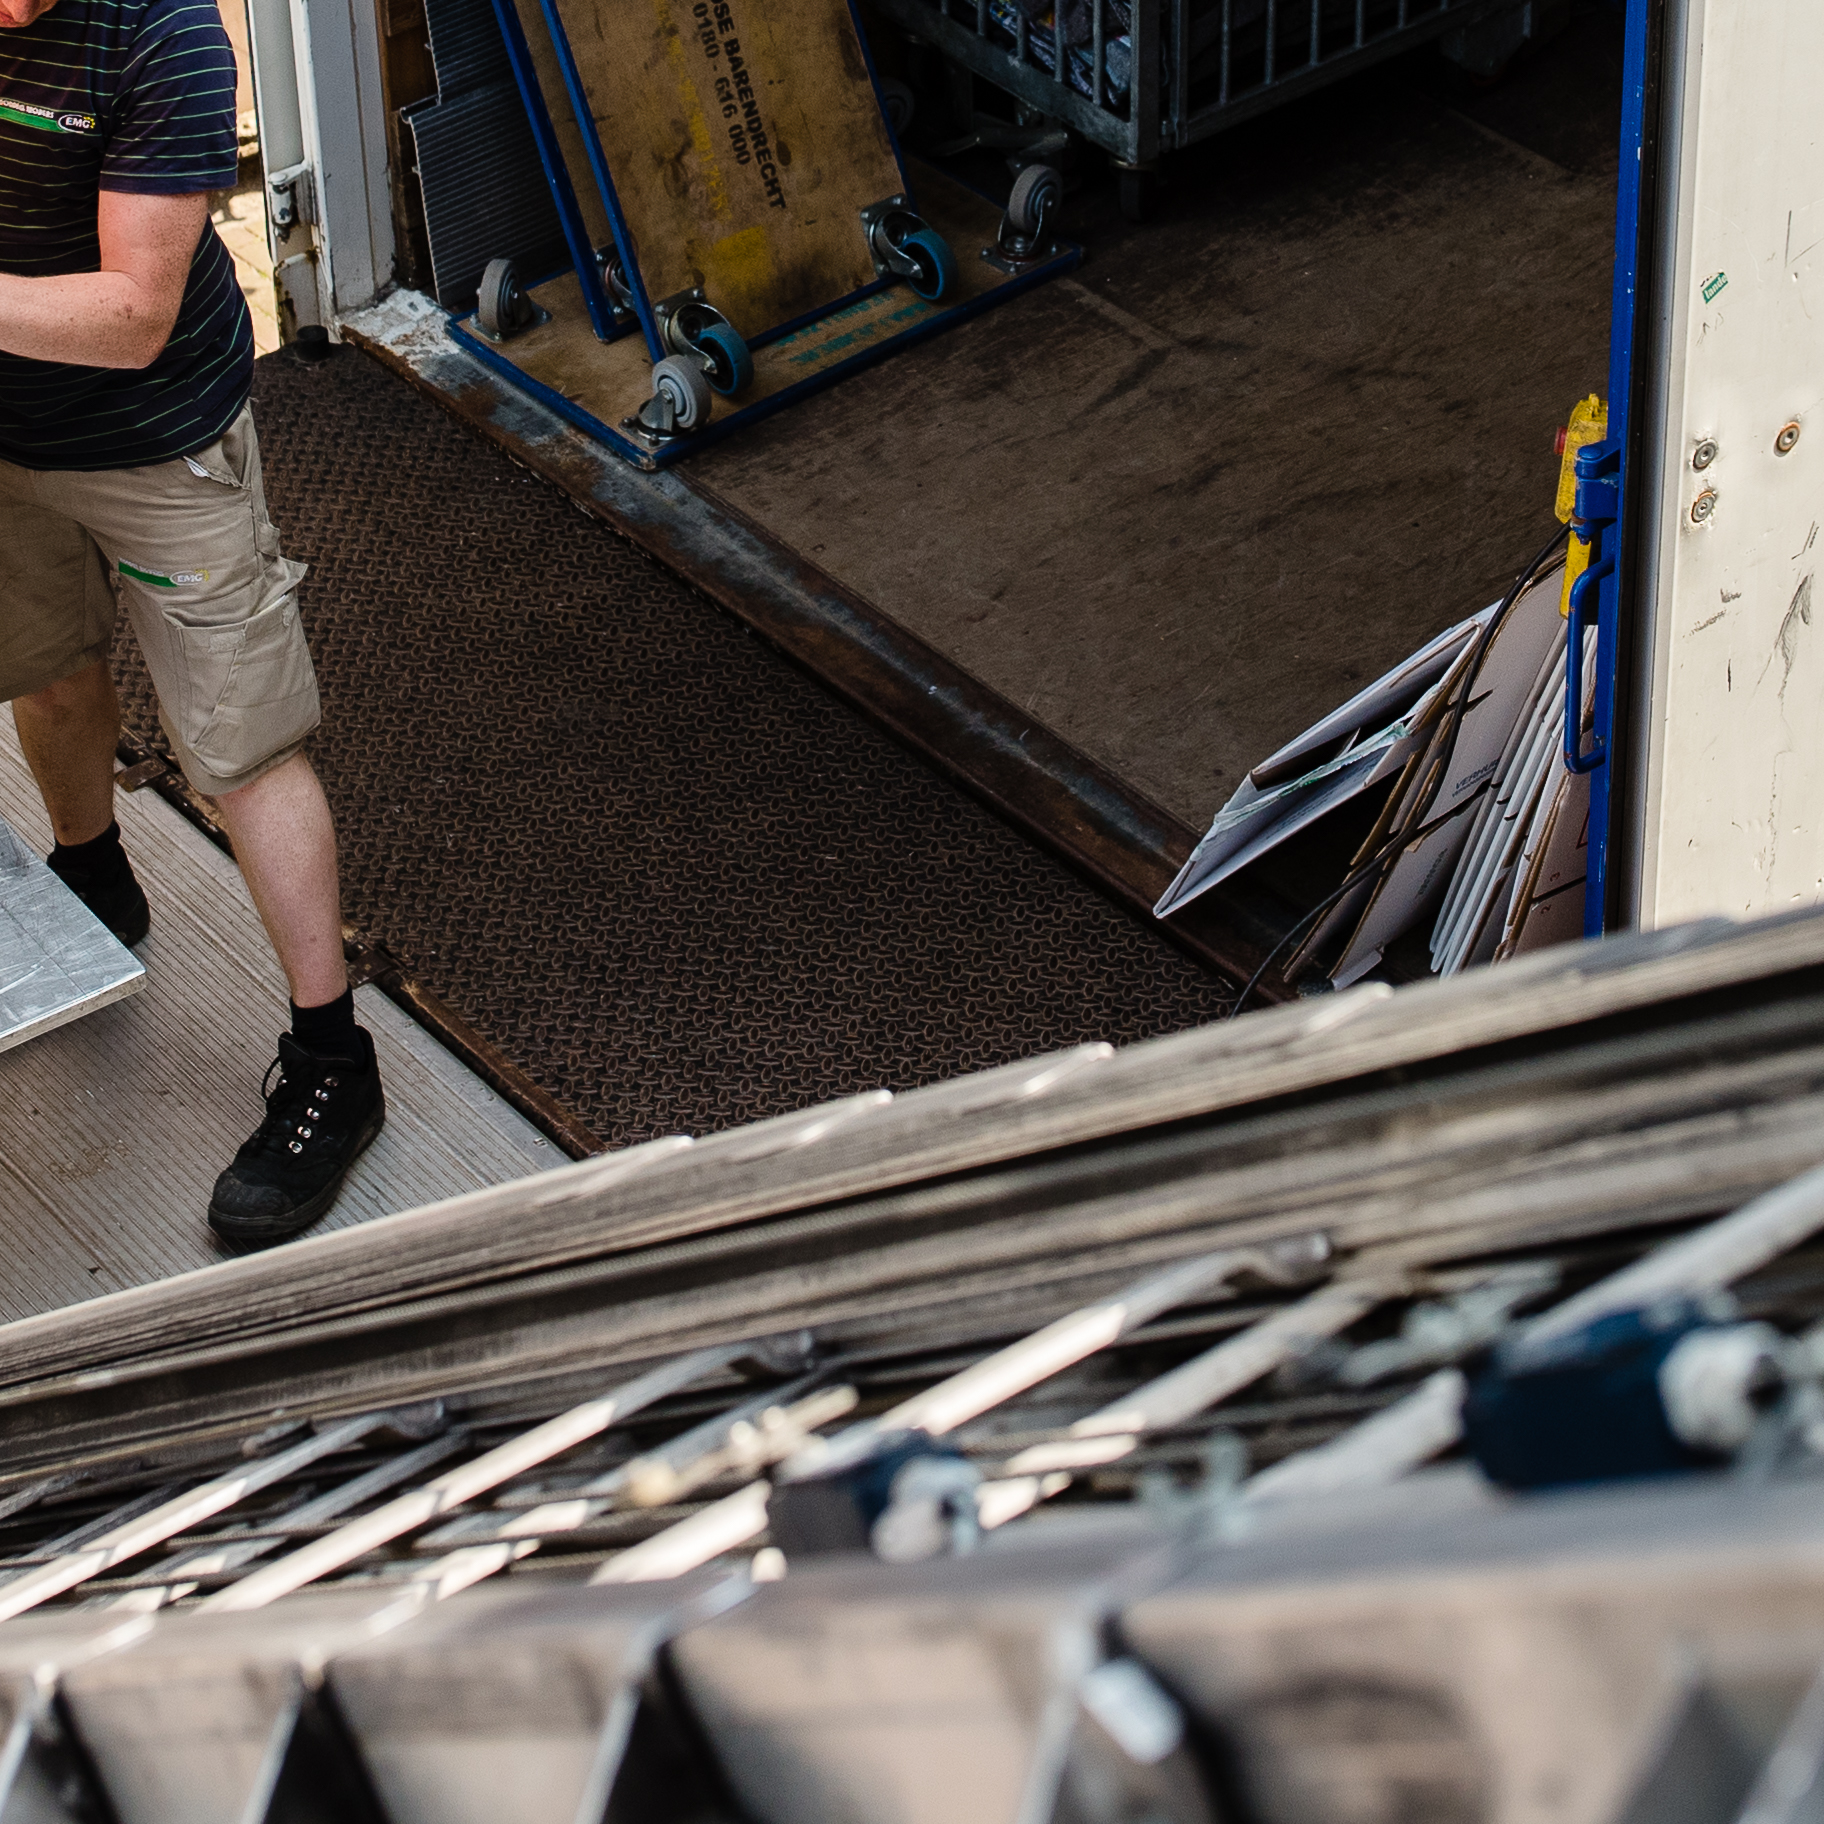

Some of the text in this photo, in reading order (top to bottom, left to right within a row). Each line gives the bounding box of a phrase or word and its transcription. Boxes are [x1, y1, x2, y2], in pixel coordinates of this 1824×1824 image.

[691, 1, 718, 60] 0180
[712, 76, 737, 118] 616
[728, 121, 751, 167] 000
[725, 38, 787, 210] BARENDRECHT
[177, 573, 203, 584] EMG
